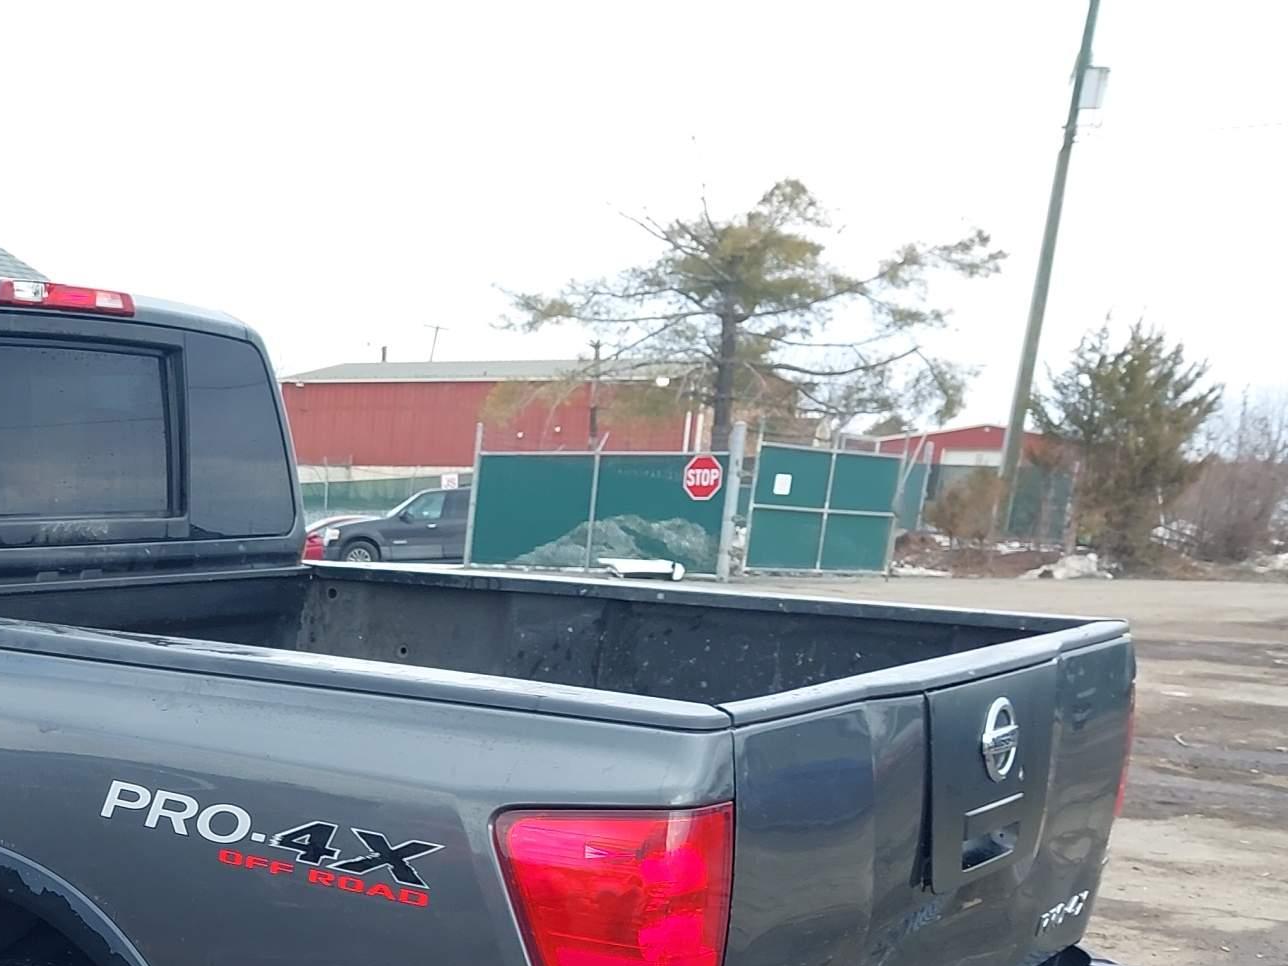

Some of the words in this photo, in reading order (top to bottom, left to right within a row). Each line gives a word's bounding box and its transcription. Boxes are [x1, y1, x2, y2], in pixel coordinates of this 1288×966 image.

[686, 468, 720, 488] STOP
[217, 848, 296, 876] OFF
[307, 868, 430, 908] ROAD
